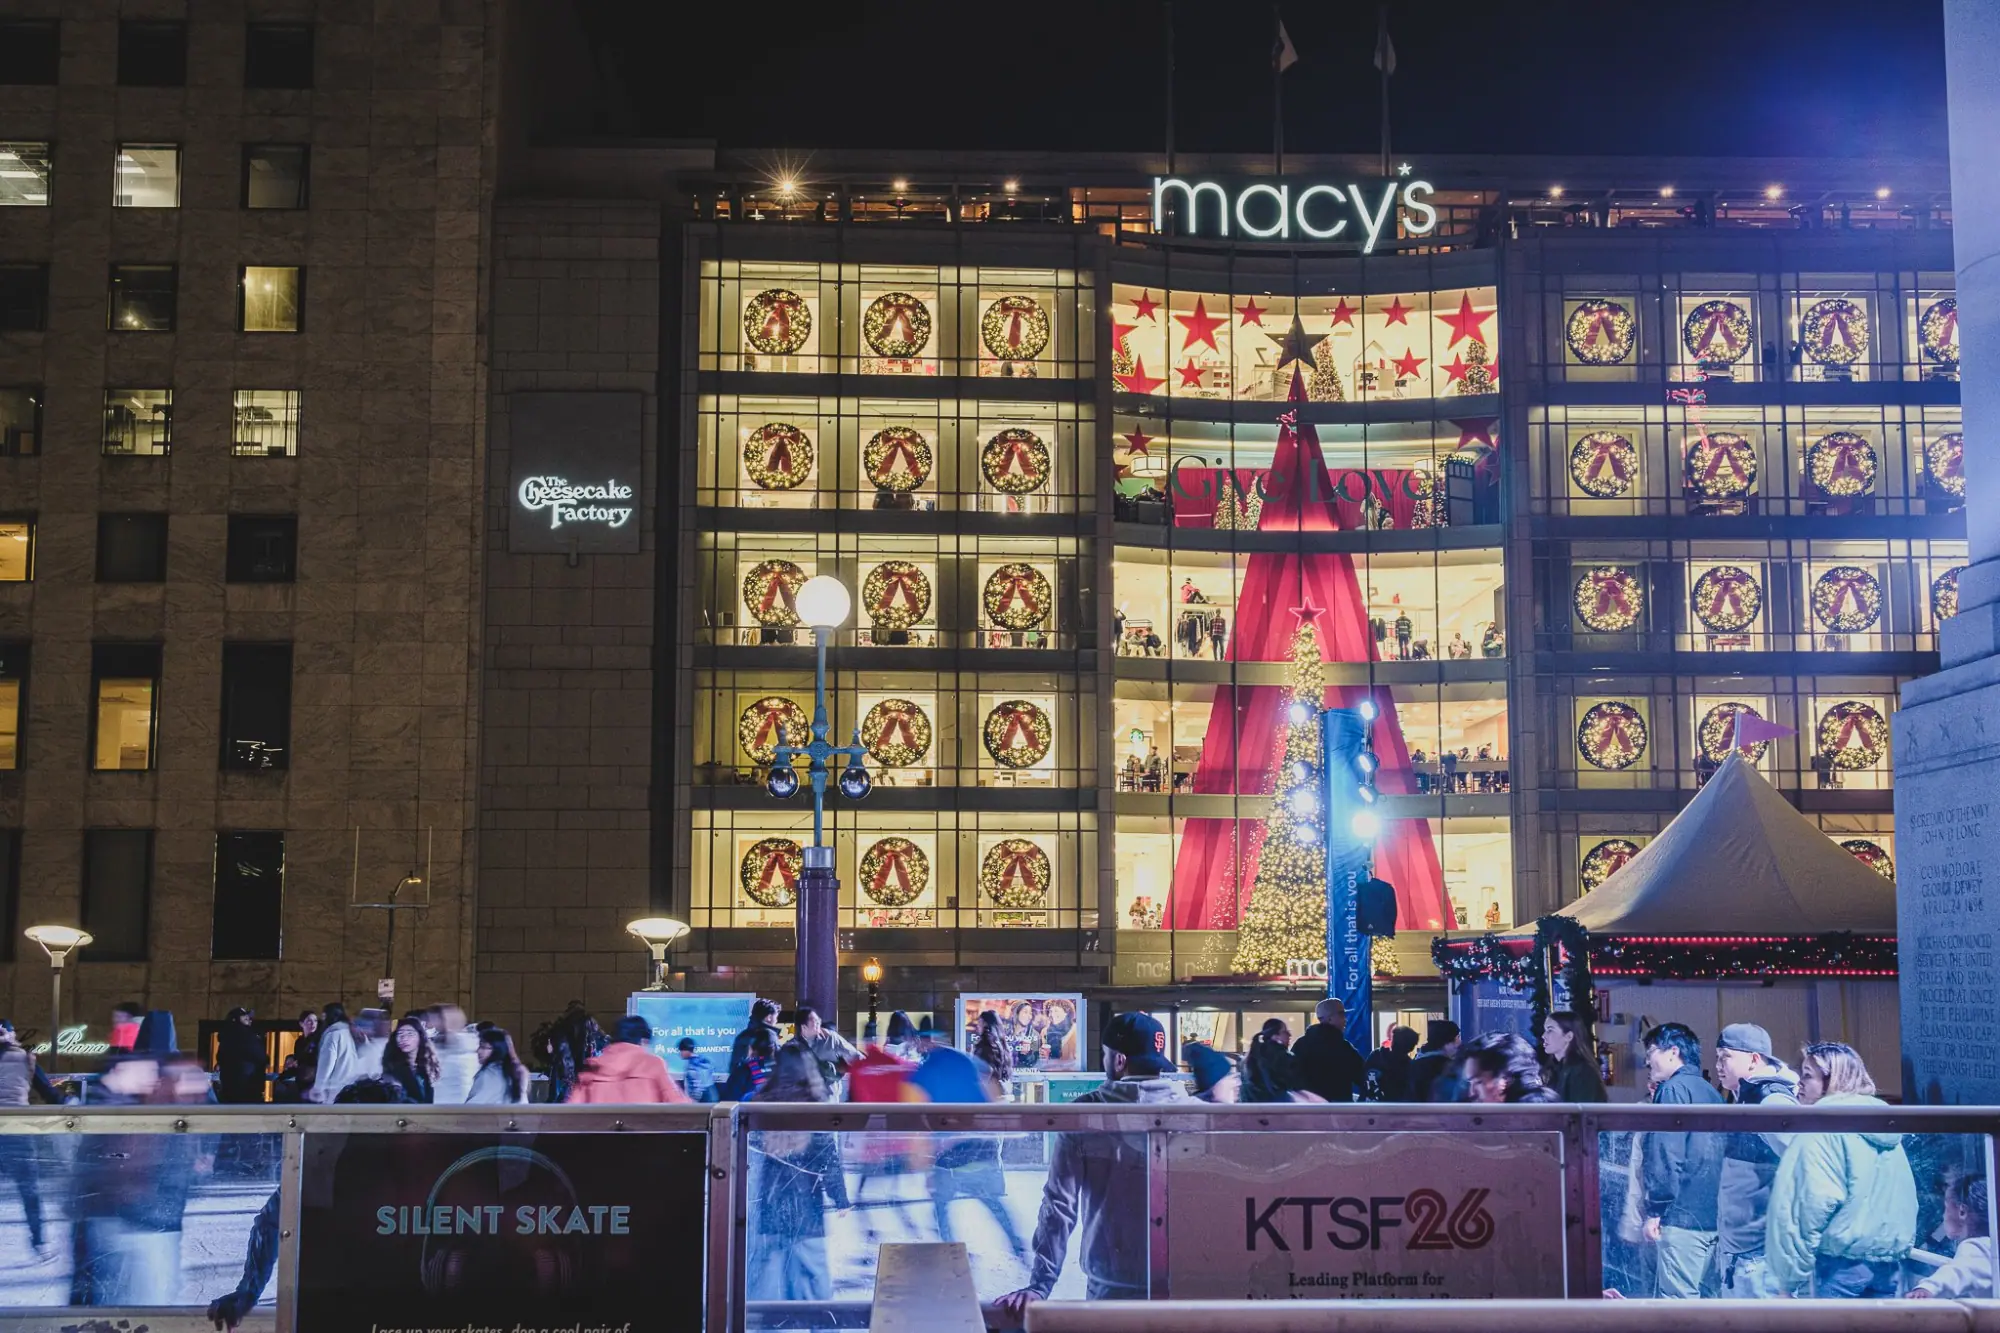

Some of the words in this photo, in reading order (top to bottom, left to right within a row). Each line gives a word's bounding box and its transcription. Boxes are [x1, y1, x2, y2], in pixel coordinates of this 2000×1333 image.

[1155, 163, 1437, 253] macy's
[546, 476, 567, 486] The
[1172, 455, 1286, 502] Give
[1310, 459, 1432, 503] Love
[519, 476, 632, 510] Cheesecake
[541, 499, 632, 529] Factory
[1956, 823, 1981, 840] LONG
[1921, 861, 1982, 880] COMMODORE
[1345, 900, 1358, 912] is
[1345, 914, 1358, 942] that
[1345, 947, 1358, 963] all
[1966, 952, 1992, 967] UNITED
[1345, 968, 1358, 991] For
[1946, 970, 1964, 985] AND
[1970, 989, 1995, 1004] ONCE
[652, 1026, 668, 1037] For
[671, 1026, 682, 1037] all
[685, 1025, 705, 1036] that
[707, 1025, 715, 1036] is
[718, 1027, 736, 1038] you
[971, 1034, 981, 1042] Fo
[1955, 1025, 1973, 1040] AND
[693, 1045, 731, 1053] ERMANENTE
[376, 1205, 504, 1235] SILENT
[516, 1205, 631, 1235] SKATE
[1288, 1271, 1348, 1290] Leading
[1352, 1271, 1418, 1287] Platform
[1422, 1270, 1445, 1287] for
